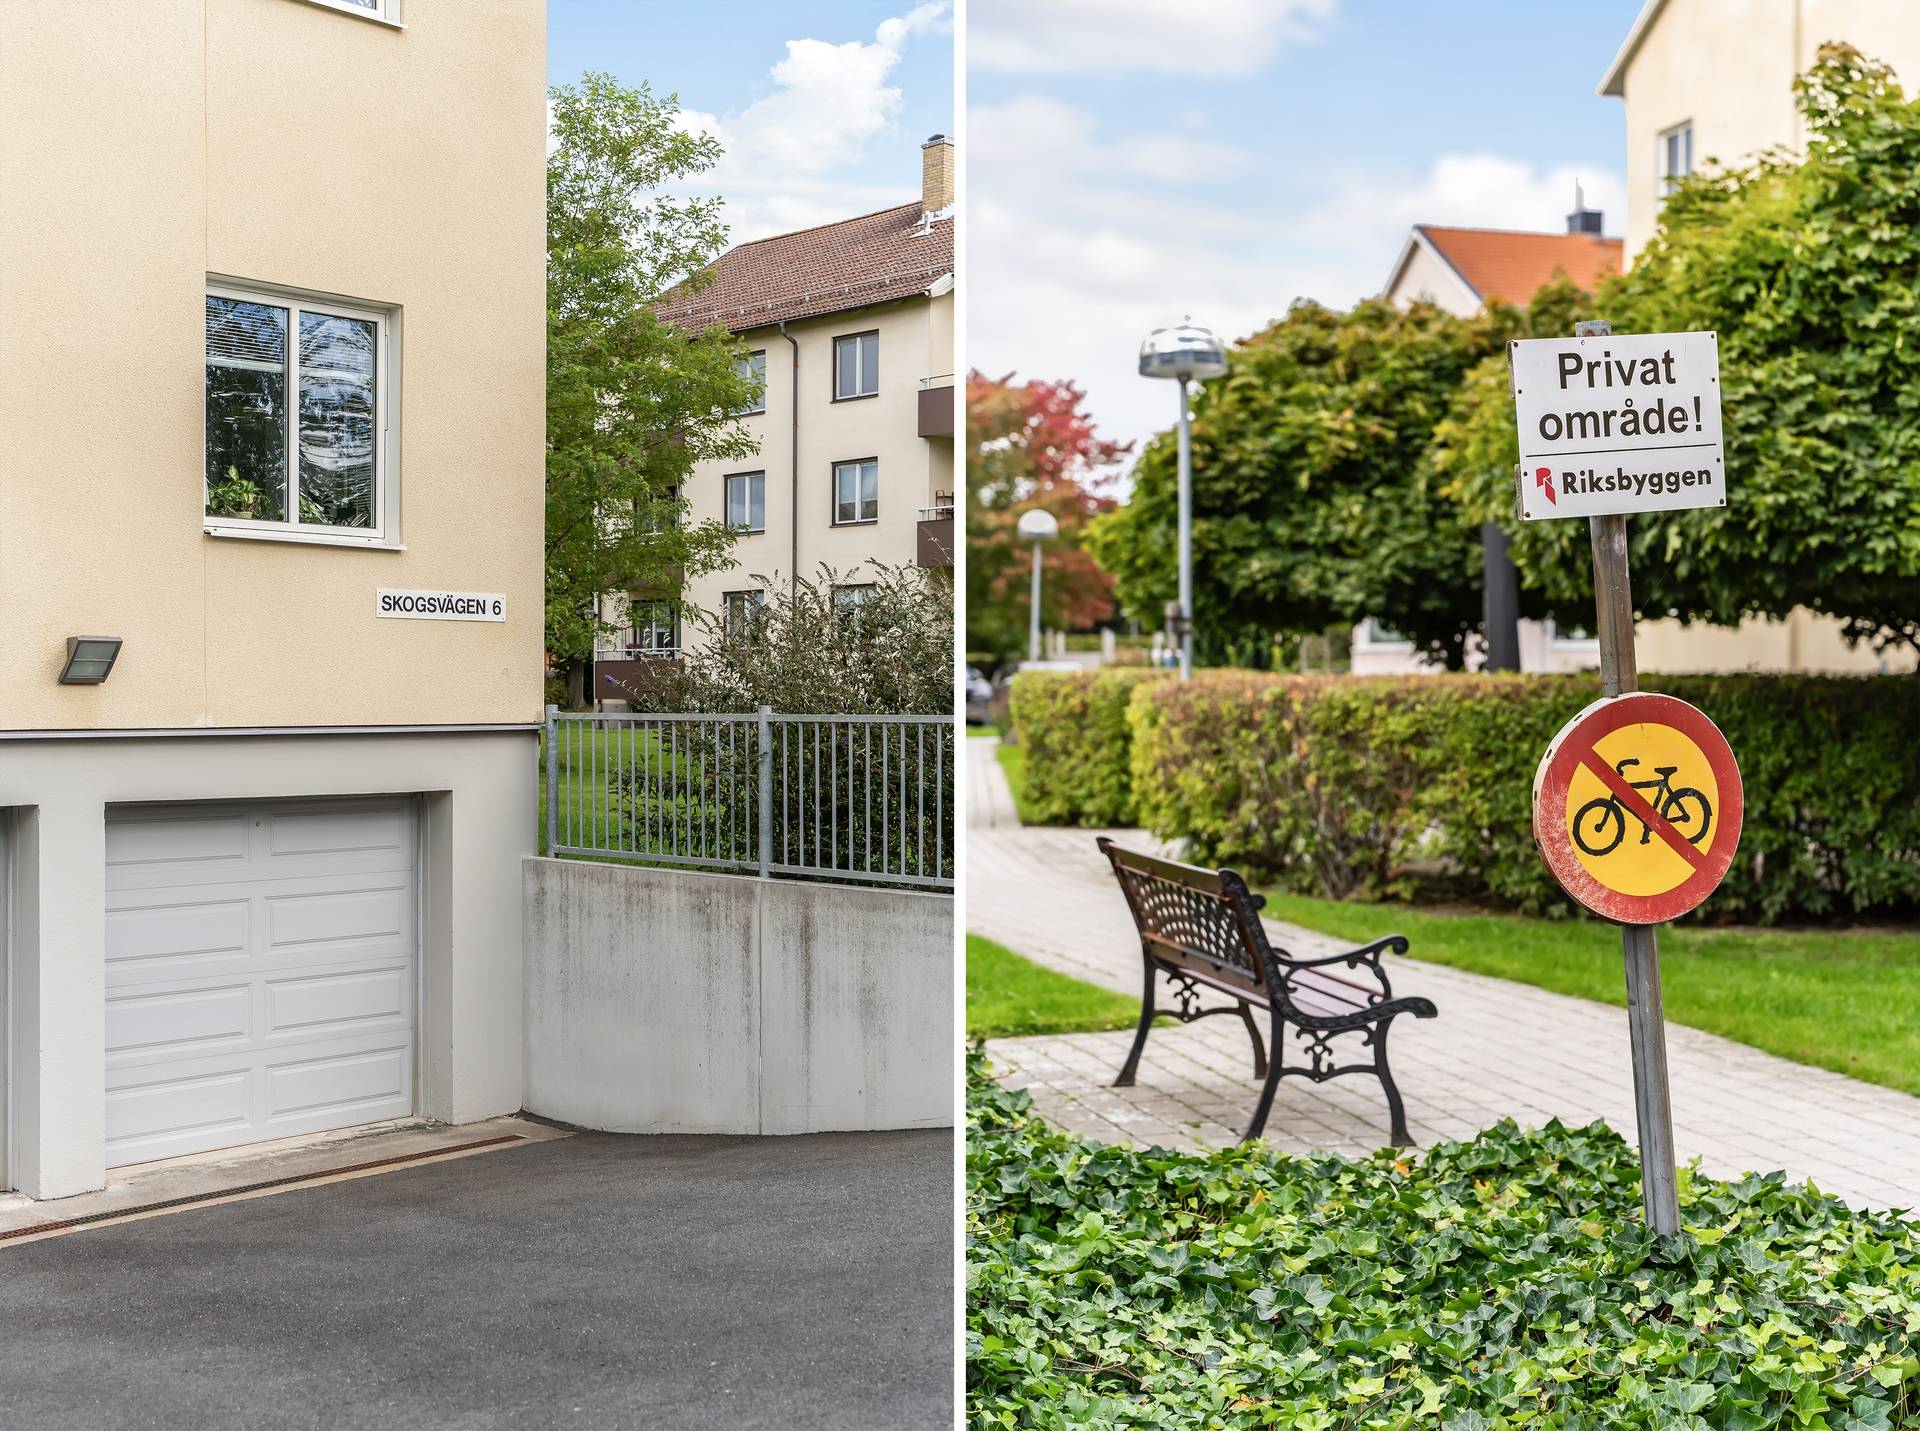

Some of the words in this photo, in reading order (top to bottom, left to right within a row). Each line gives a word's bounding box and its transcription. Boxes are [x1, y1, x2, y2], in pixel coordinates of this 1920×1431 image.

[1558, 350, 1677, 390] Privat
[1539, 396, 1702, 441] område!
[1562, 467, 1712, 496] Riksbyggen
[381, 594, 487, 615] SKOGSVÄGEN
[492, 600, 502, 616] 6
